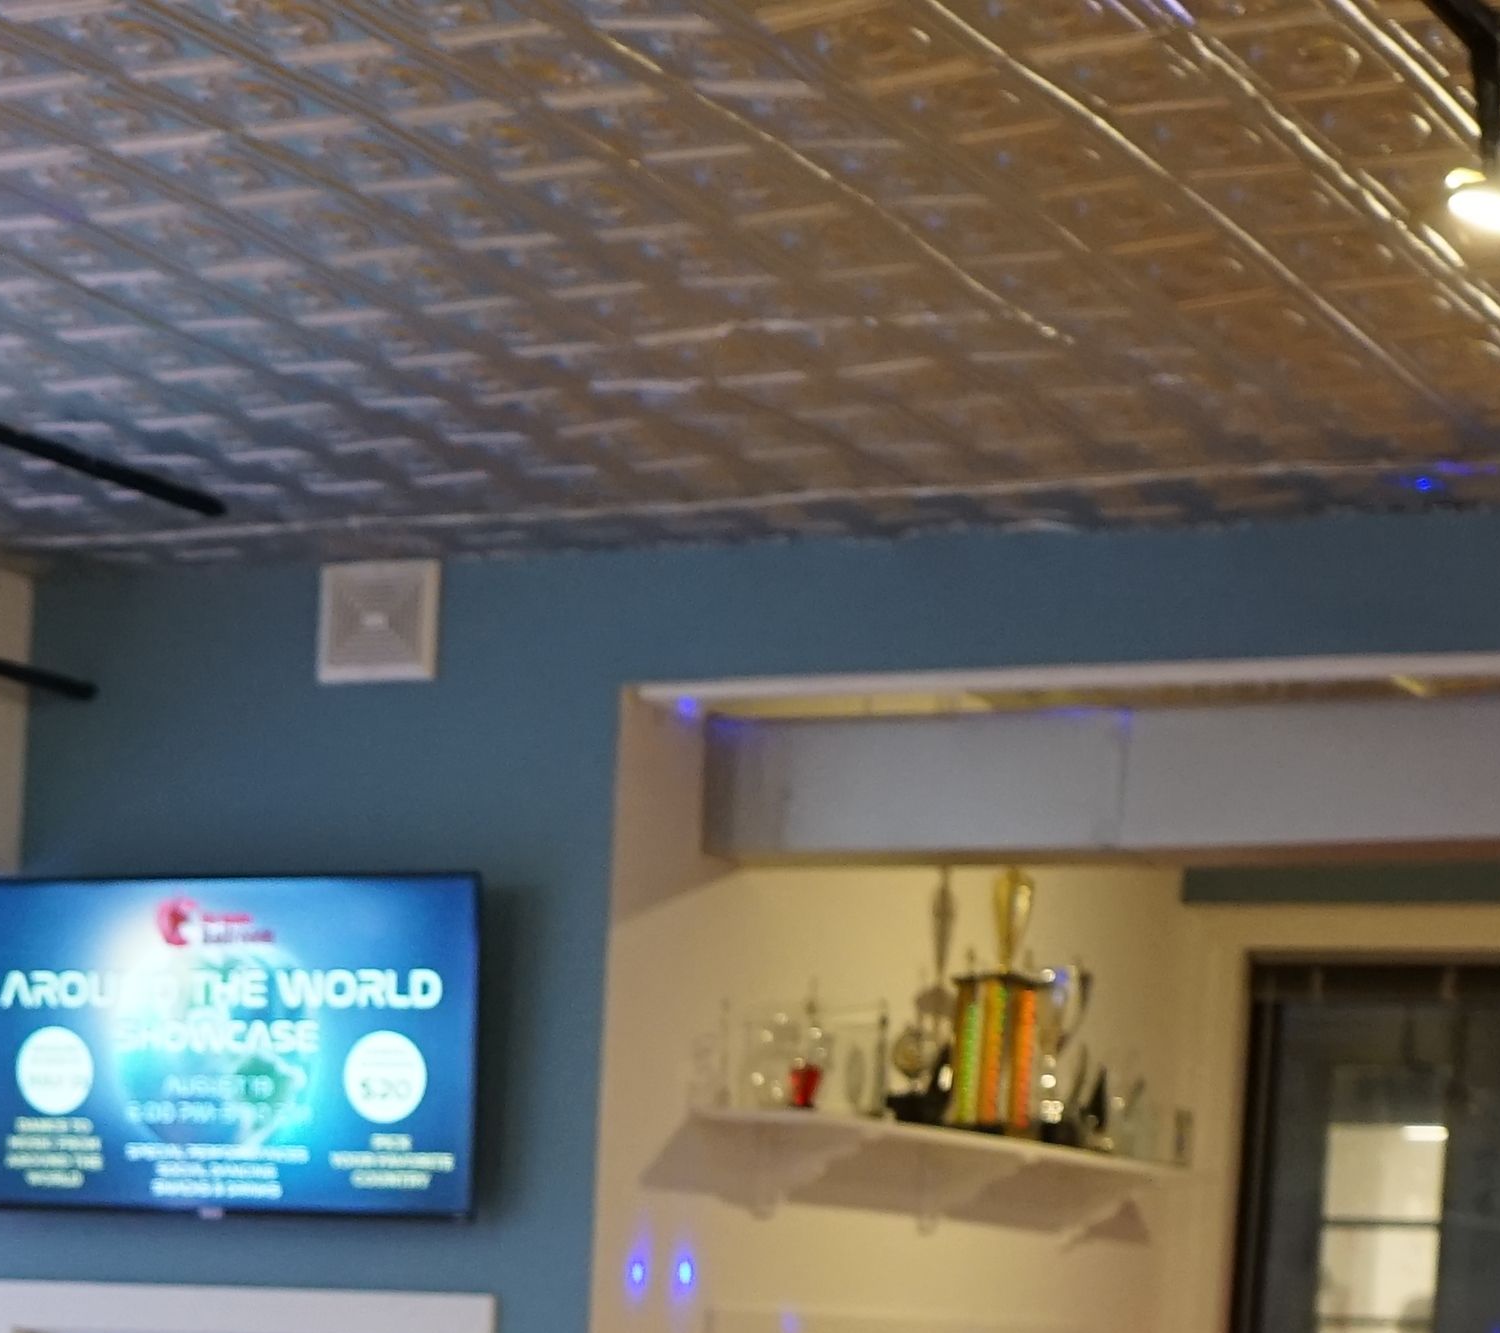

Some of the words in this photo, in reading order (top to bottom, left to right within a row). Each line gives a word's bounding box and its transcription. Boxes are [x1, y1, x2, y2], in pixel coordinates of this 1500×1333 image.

[0, 968, 178, 1010] AROUD
[191, 968, 268, 1009] THE
[277, 968, 443, 1010] WORLD
[114, 1020, 320, 1055] SHOWCASE
